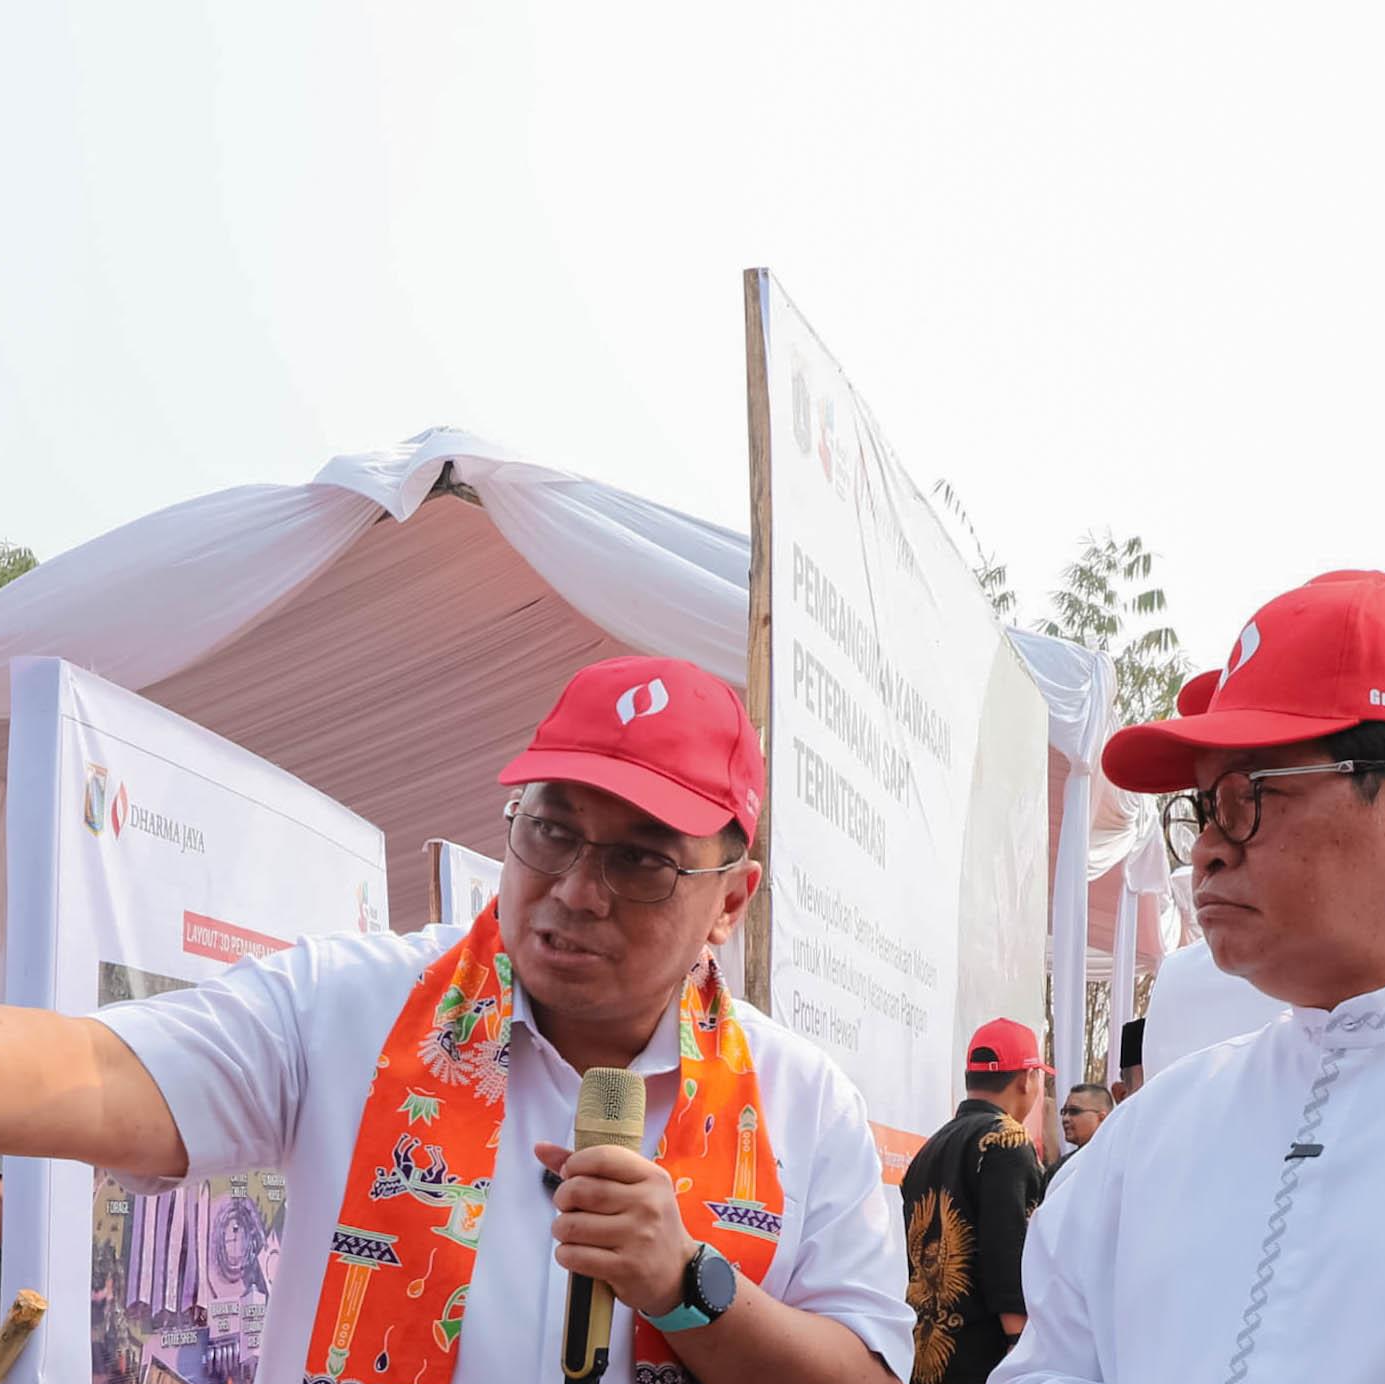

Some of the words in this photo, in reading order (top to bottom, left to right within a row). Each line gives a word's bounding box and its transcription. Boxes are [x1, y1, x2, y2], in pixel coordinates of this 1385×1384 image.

[793, 637, 881, 784] PETERNAKAN
[882, 740, 910, 809] SAPI
[130, 803, 180, 845] DHARMA
[180, 824, 206, 855] JAYA
[793, 736, 886, 871] TERINTEGRASI
[186, 922, 218, 949] LAYOUT
[792, 989, 828, 1040] Protein
